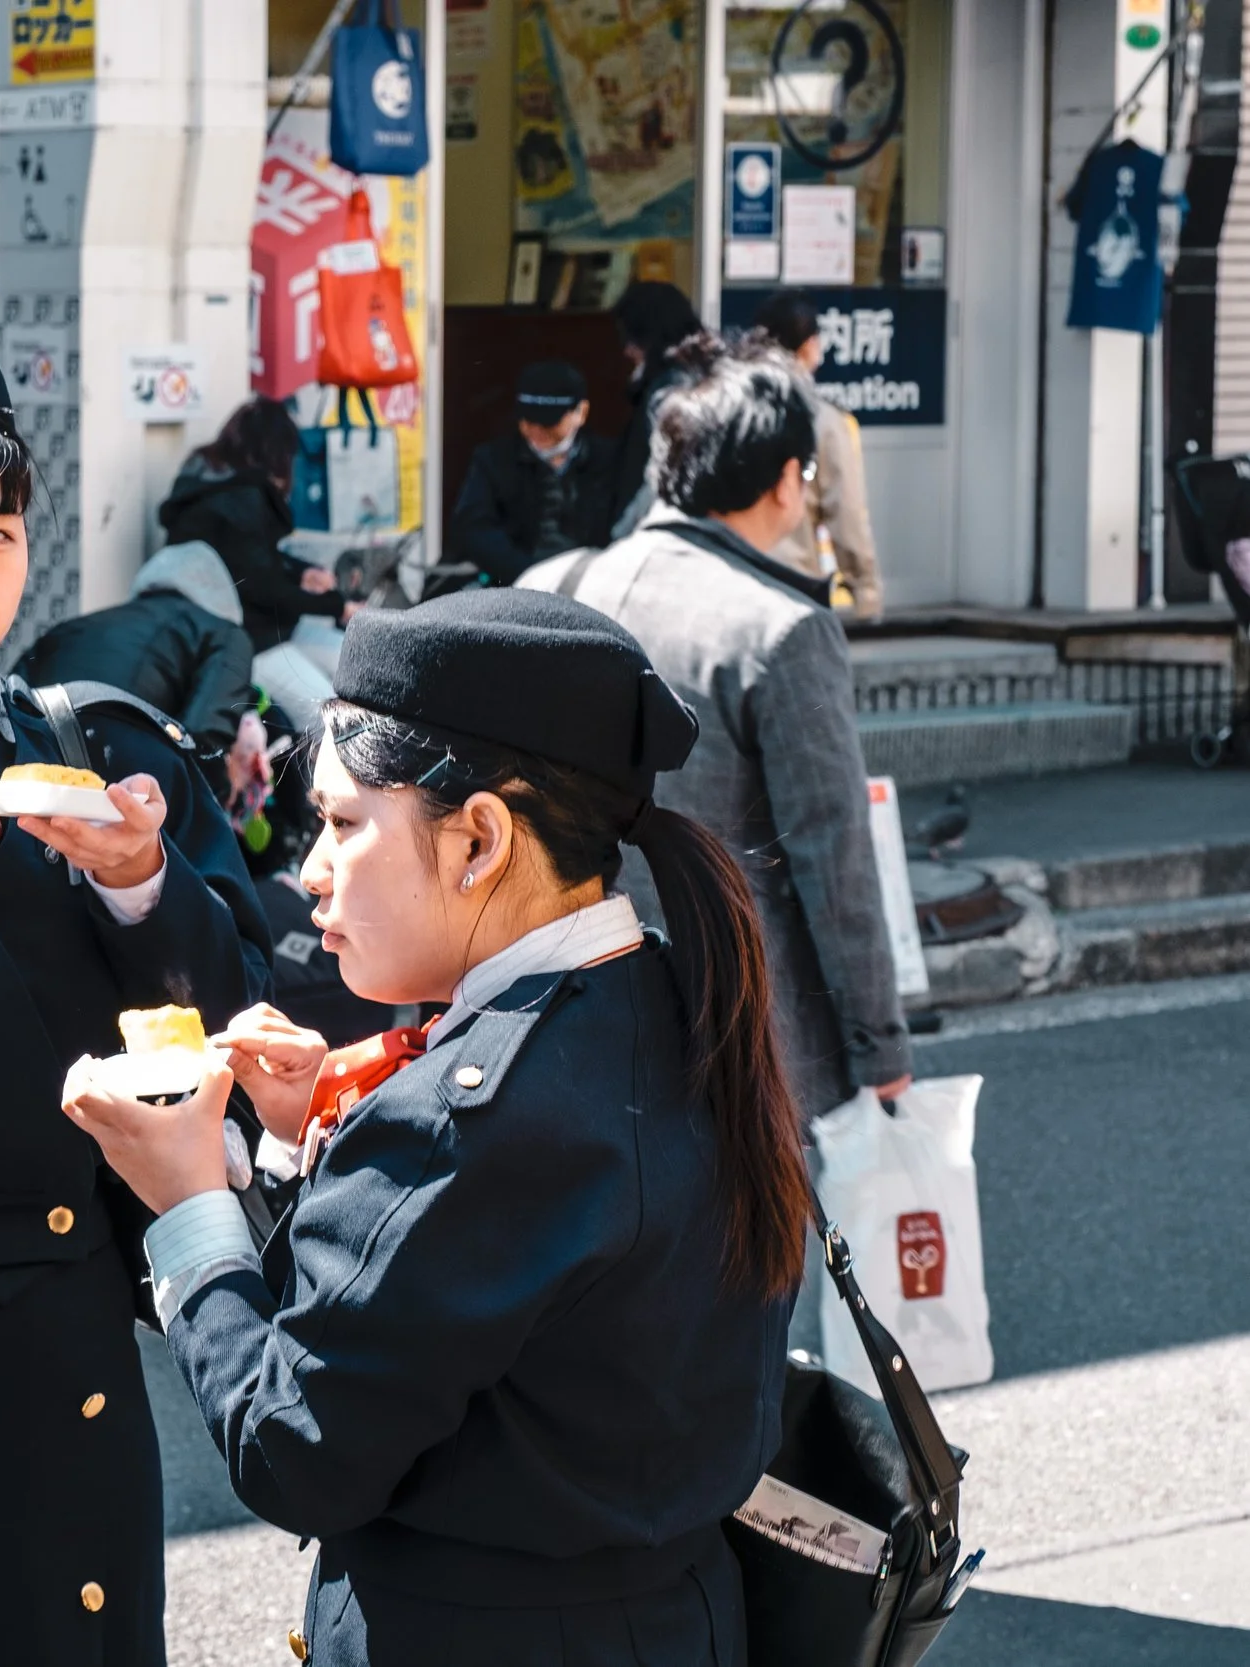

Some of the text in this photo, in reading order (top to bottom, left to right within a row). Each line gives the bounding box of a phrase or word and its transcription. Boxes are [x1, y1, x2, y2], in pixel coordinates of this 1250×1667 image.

[14, 15, 93, 44] ロッカー
[816, 306, 894, 366] 内所
[815, 374, 920, 411] mation
